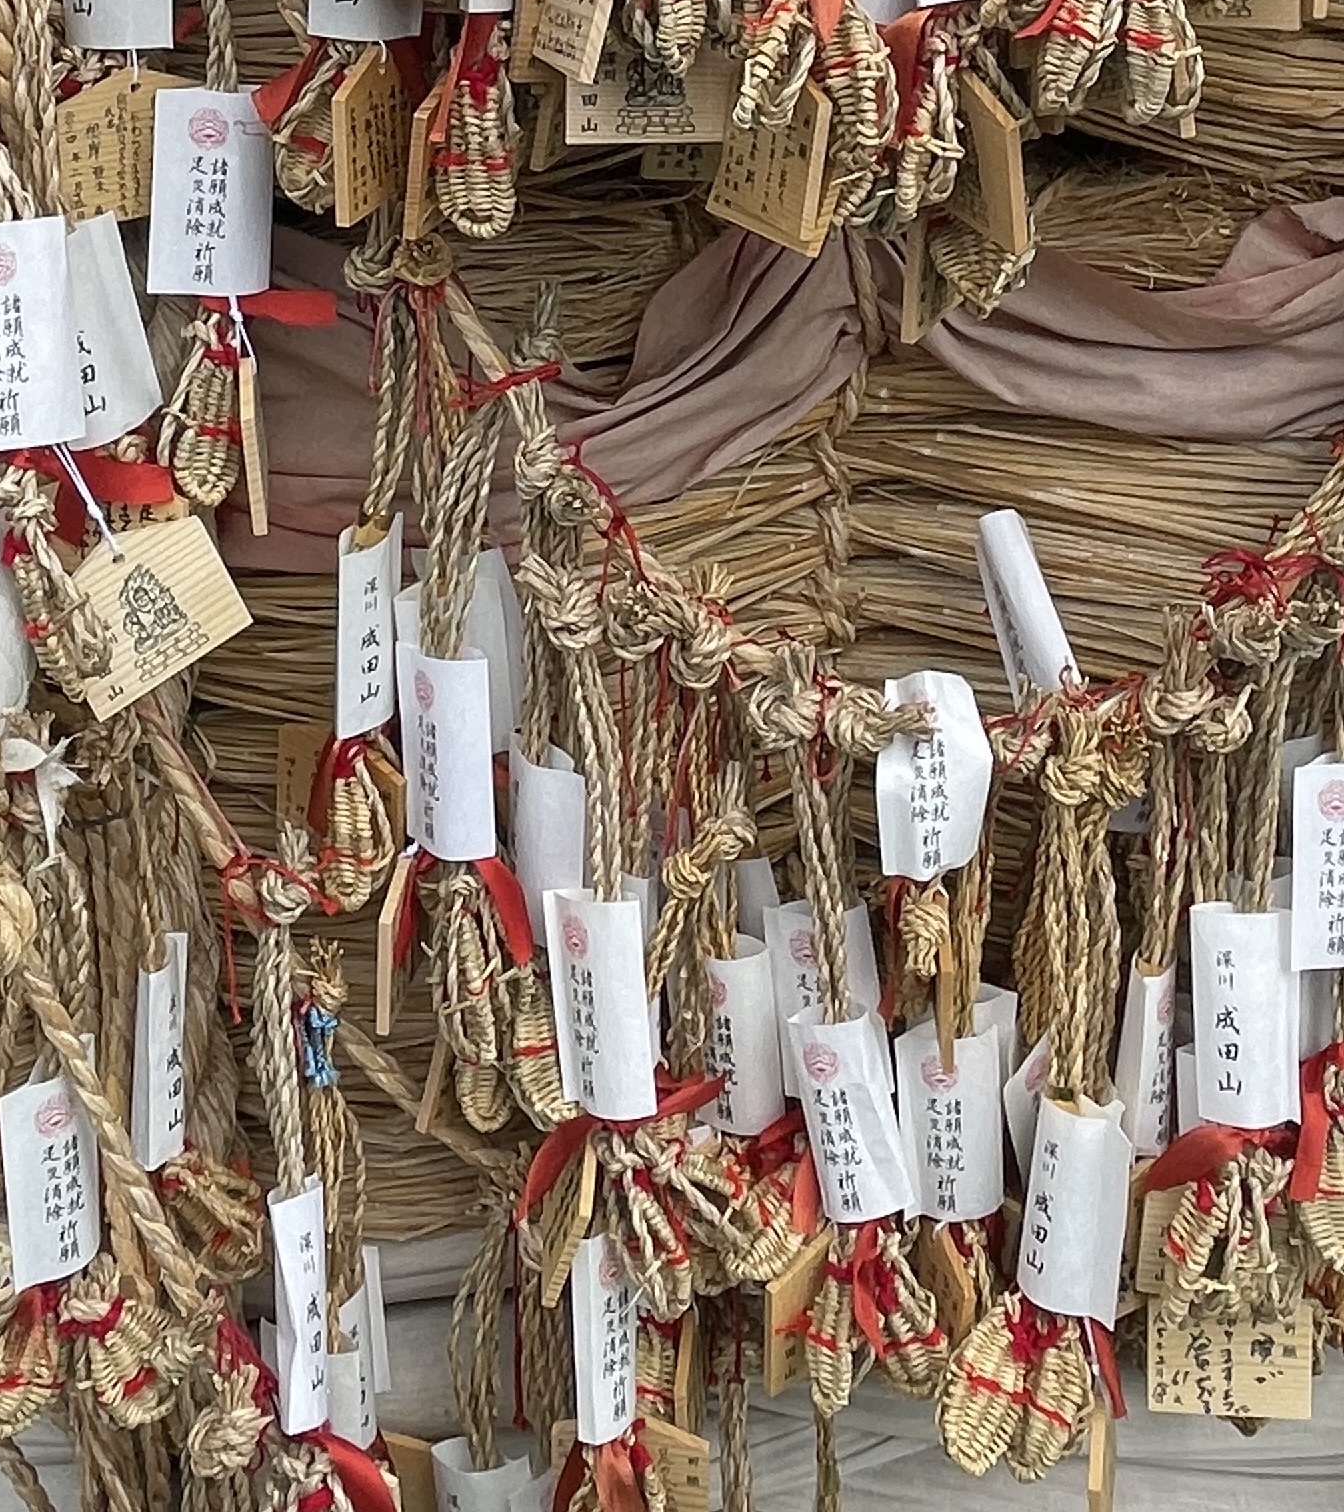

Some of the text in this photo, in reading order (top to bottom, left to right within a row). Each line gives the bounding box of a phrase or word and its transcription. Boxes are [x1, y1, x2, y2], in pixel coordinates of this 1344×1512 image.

[193, 241, 216, 285] 祈願
[360, 623, 380, 704] 成田山
[922, 828, 942, 868] 祈願
[1215, 1006, 1241, 1095] 成田山
[838, 1172, 861, 1212] 祈願
[935, 1177, 956, 1213] 祈願
[59, 1218, 81, 1261] 祈願
[1027, 1193, 1050, 1274] 成田山
[305, 1295, 324, 1392] 成田山
